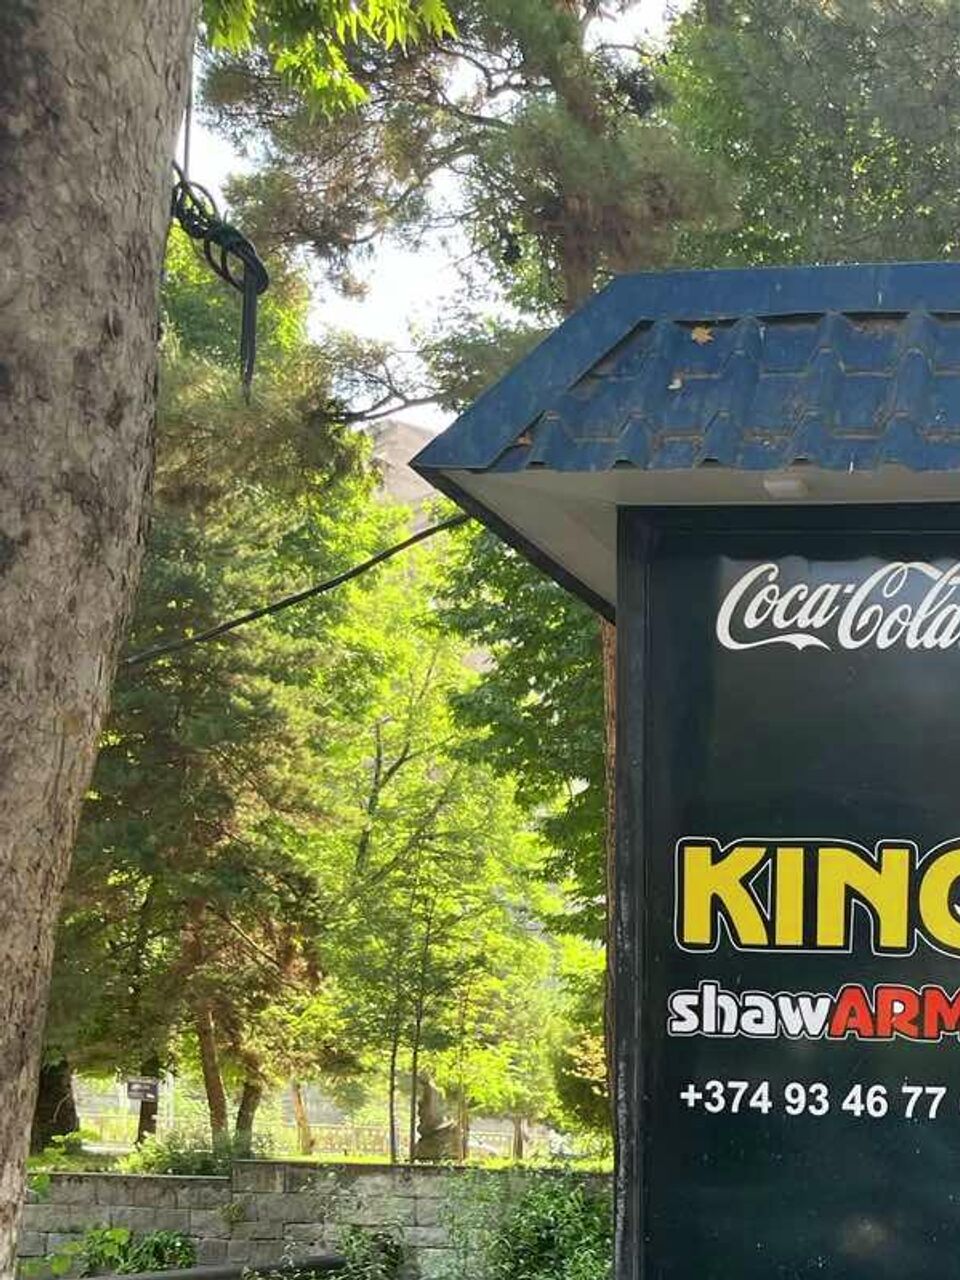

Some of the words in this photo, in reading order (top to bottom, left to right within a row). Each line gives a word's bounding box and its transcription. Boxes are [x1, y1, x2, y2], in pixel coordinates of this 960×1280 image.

[679, 1080, 773, 1115] +374
[784, 1082, 830, 1117] 93
[841, 1084, 889, 1118] 46
[902, 1086, 946, 1119] 77
